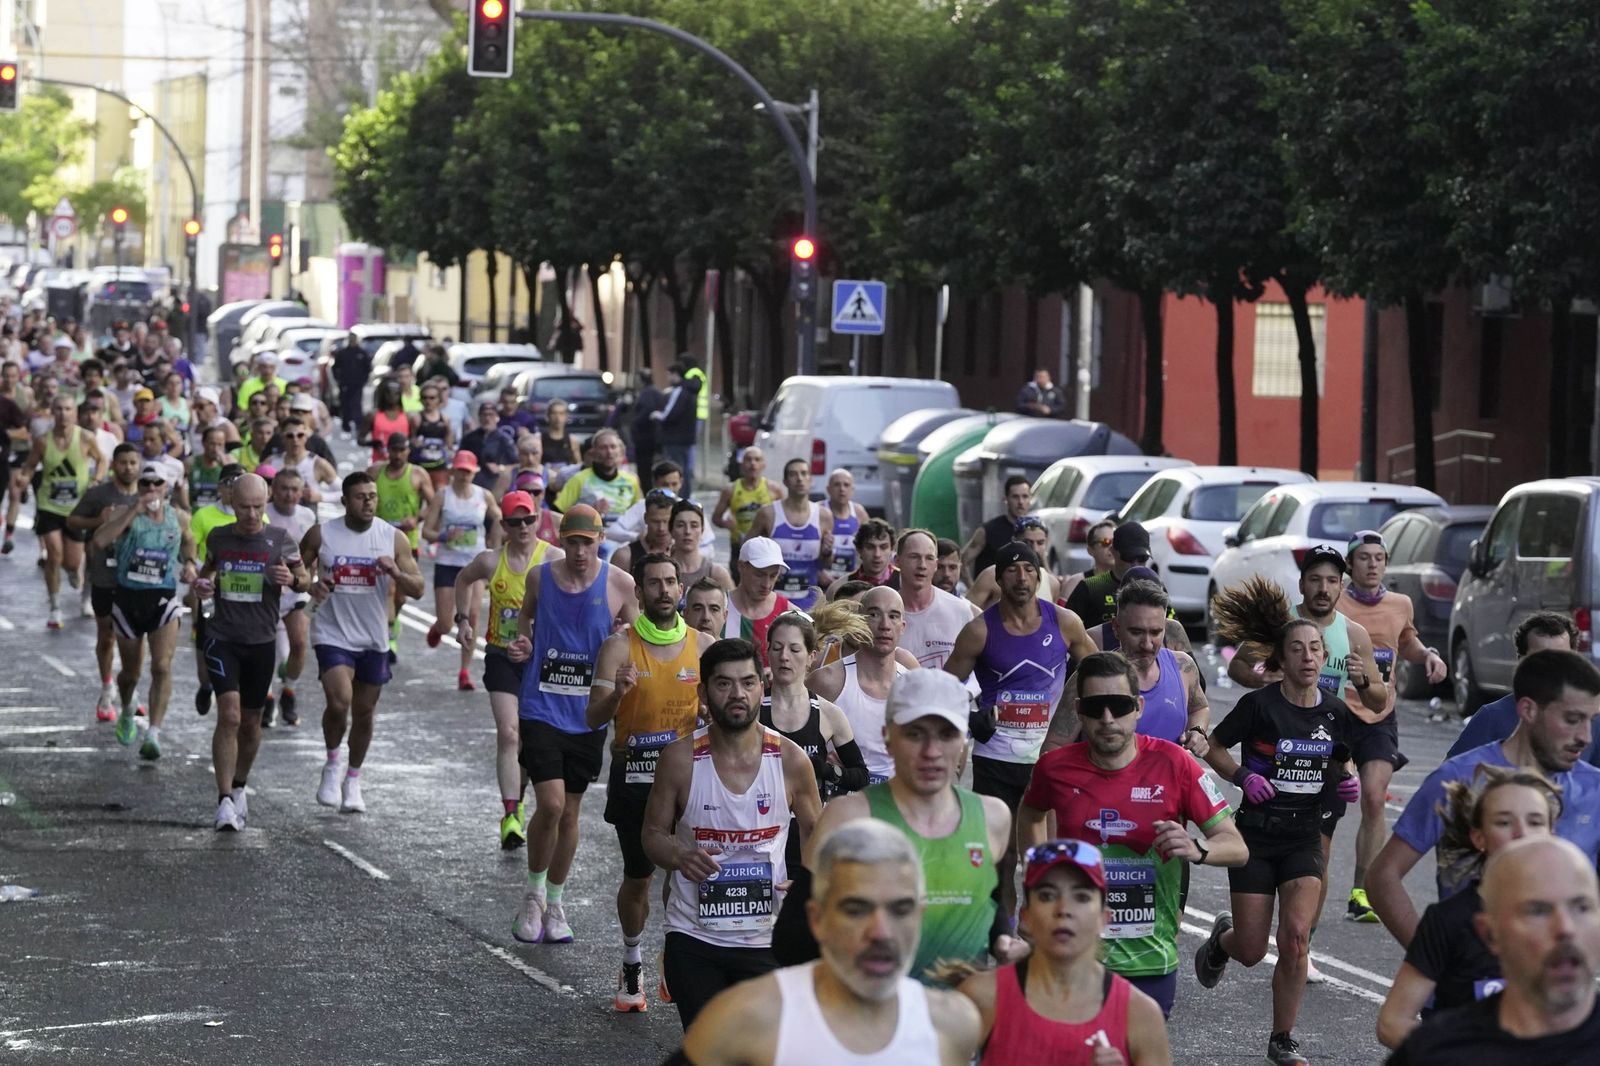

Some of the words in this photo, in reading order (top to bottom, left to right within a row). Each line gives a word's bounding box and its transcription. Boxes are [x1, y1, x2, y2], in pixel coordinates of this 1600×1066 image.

[340, 575, 369, 585] MIGUEL
[560, 652, 589, 660] ZURICH
[560, 665, 575, 673] 4479
[548, 672, 584, 685] ANTONI
[1014, 693, 1044, 701] ZURICH
[1015, 707, 1031, 715] 1467
[639, 733, 671, 745] ZURICH
[1296, 743, 1327, 752] ZURICH
[643, 750, 660, 758] 4646
[1295, 758, 1312, 767] 4730
[1277, 768, 1322, 781] PATRICIA
[724, 867, 764, 877] ZURICH
[1104, 871, 1146, 881] ZURICH
[725, 887, 748, 897] 4238
[700, 900, 772, 917] NAHUELPAN
